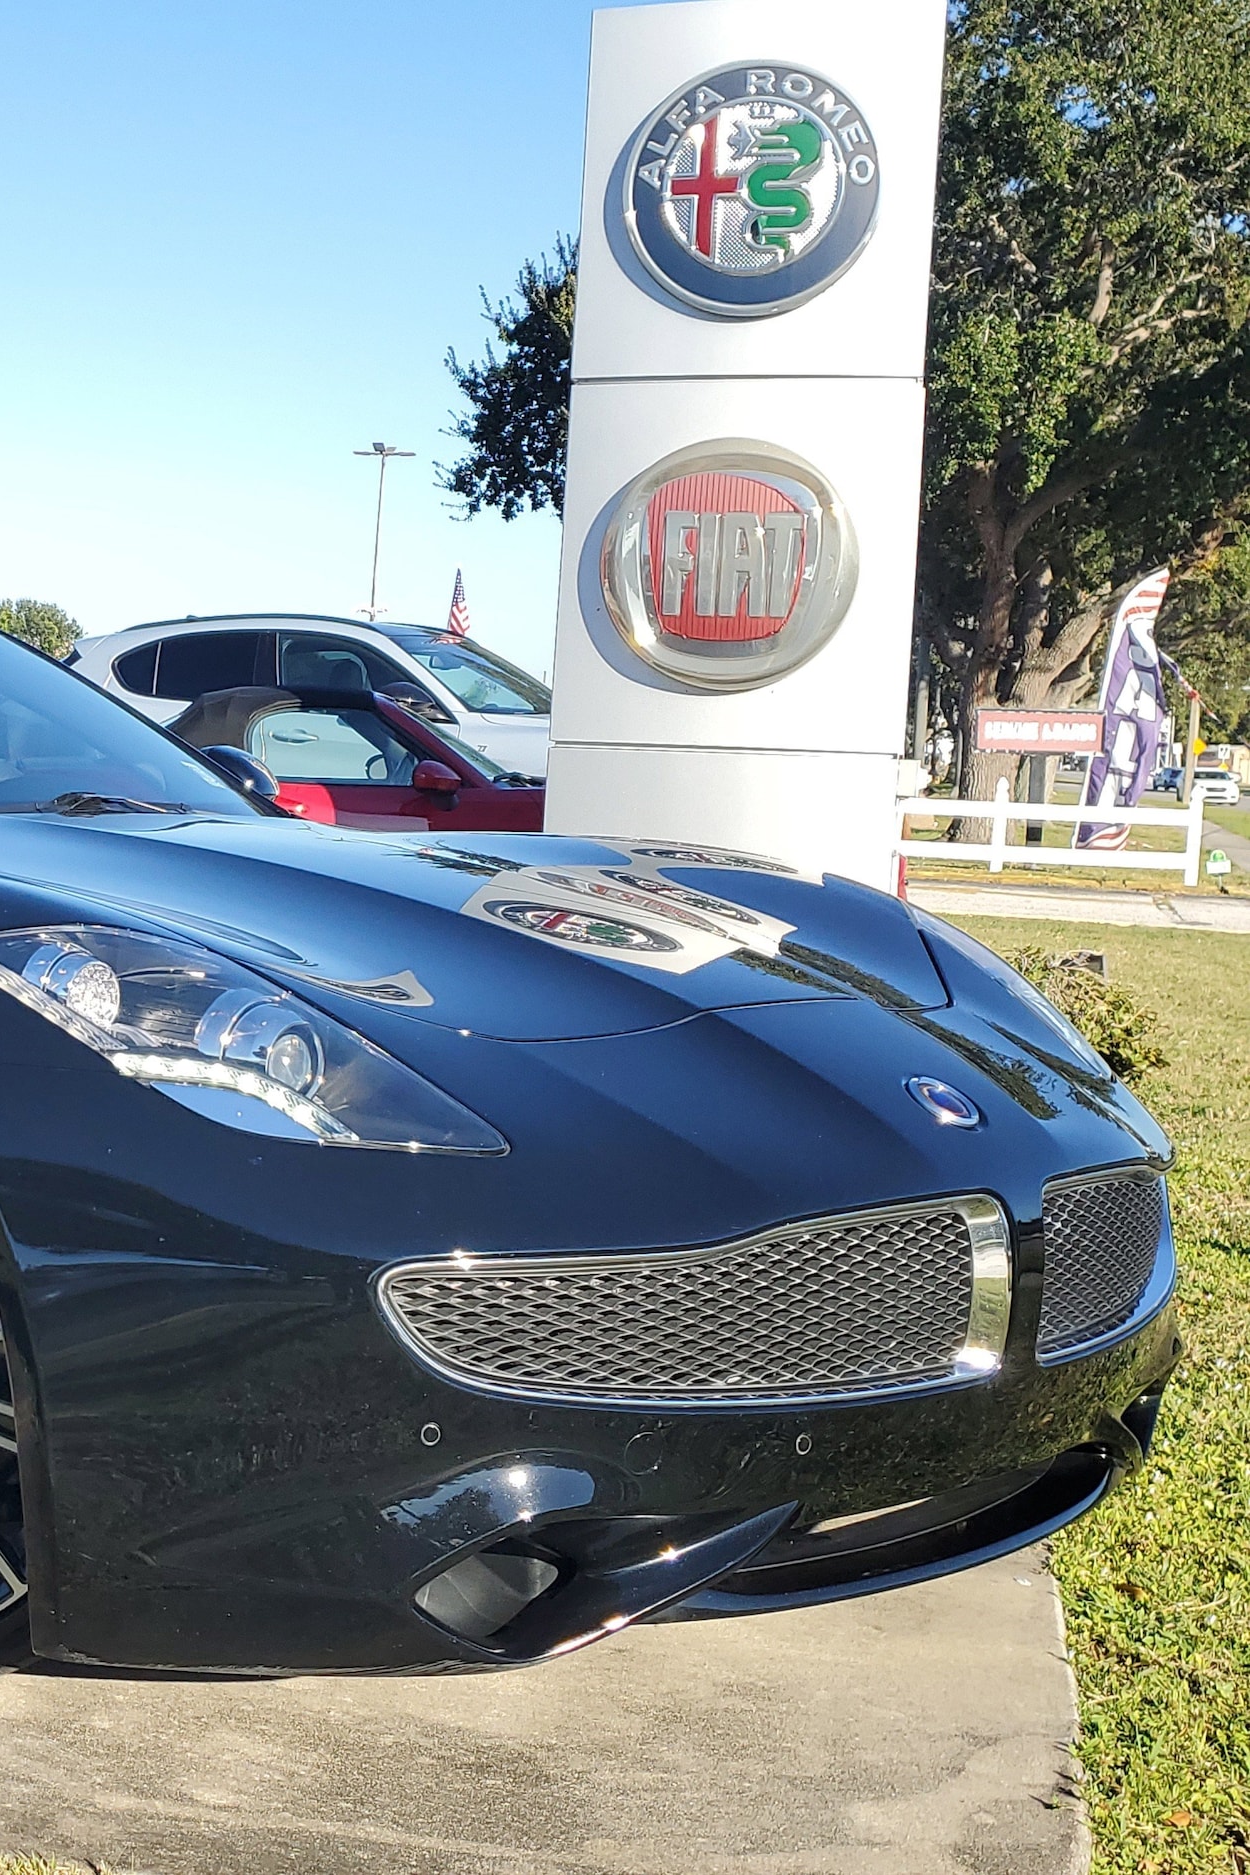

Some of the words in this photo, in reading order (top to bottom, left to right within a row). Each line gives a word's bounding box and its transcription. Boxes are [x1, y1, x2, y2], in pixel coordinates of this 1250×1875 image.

[636, 85, 726, 191] ALFA
[746, 69, 876, 186] ROMEO
[662, 510, 807, 618] FIAT
